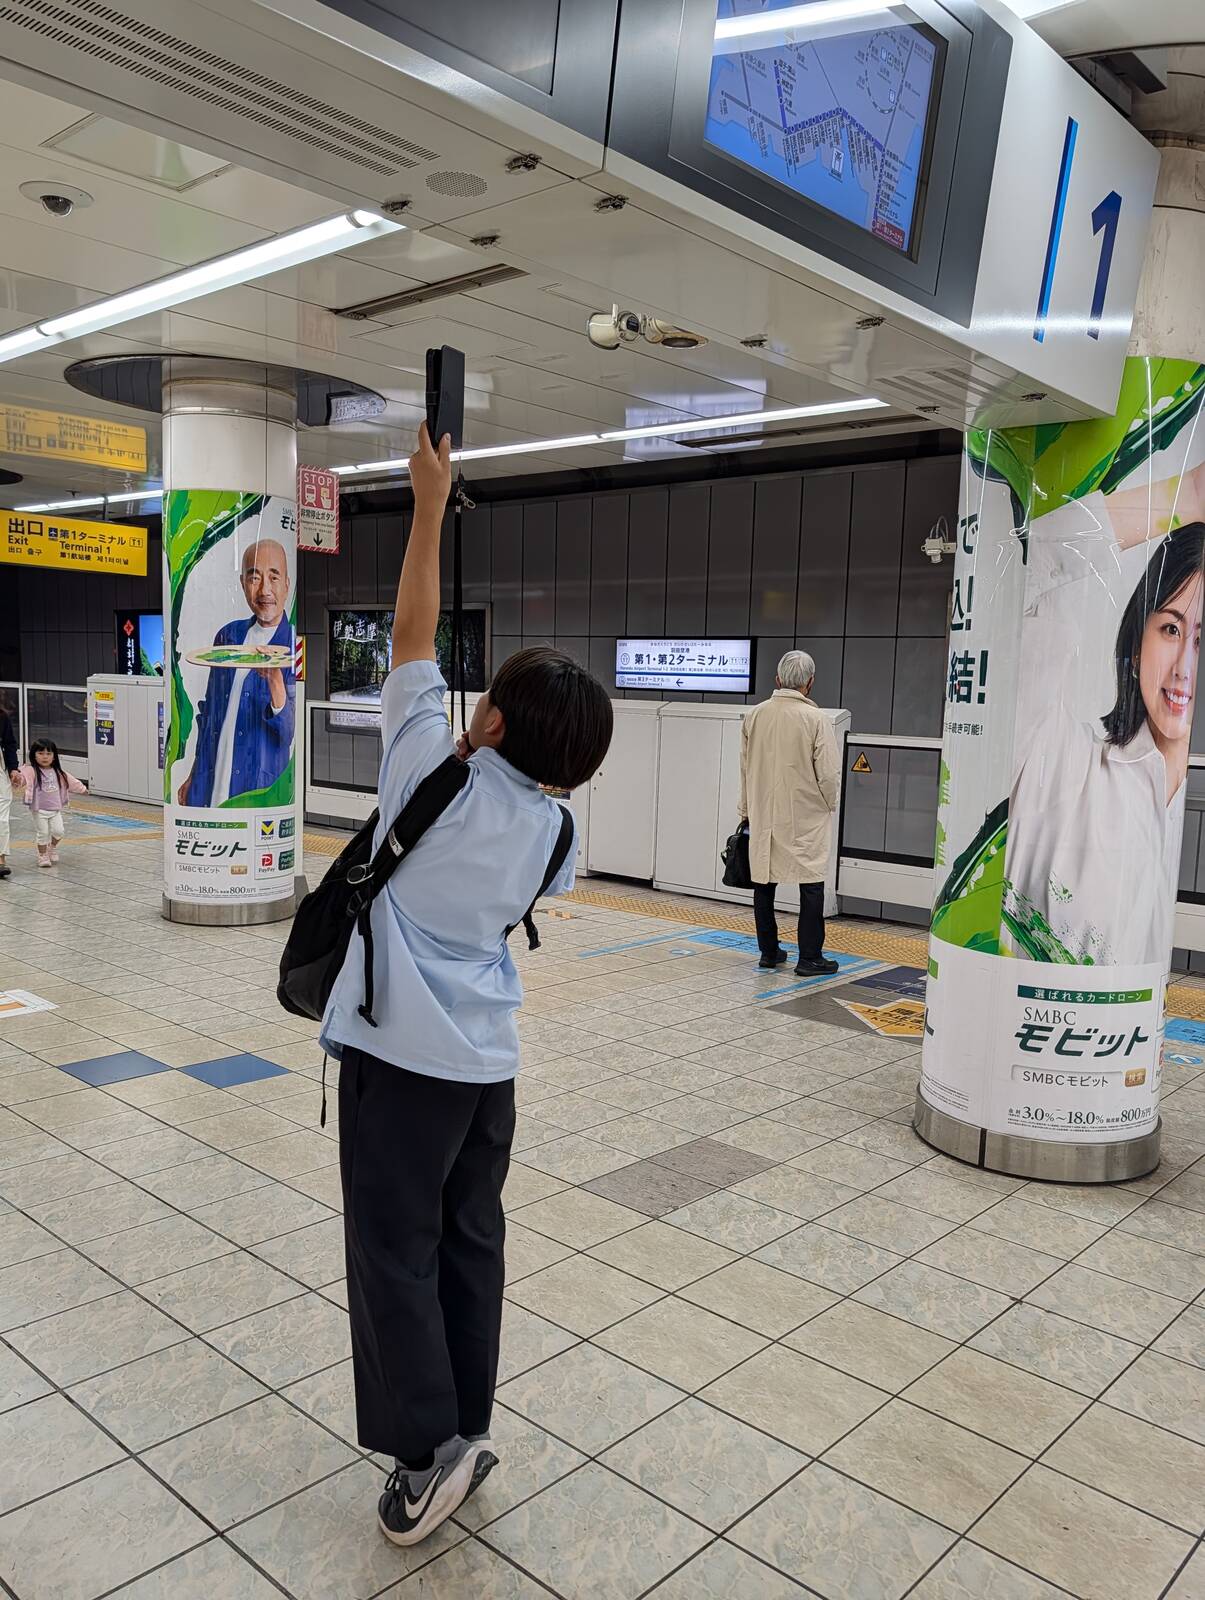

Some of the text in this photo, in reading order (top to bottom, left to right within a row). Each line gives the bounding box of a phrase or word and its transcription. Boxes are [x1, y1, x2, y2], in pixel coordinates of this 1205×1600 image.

[1087, 190, 1123, 341] 1
[304, 473, 333, 487] STOP
[301, 508, 336, 522] 非常停止ボタン
[8, 518, 44, 536] 出口
[8, 534, 29, 546] Exit
[60, 528, 127, 546] 第1ターミナル
[8, 546, 23, 554] 出口
[60, 541, 111, 554] Terminal 1
[333, 620, 378, 640] 伊勢志摩
[634, 653, 729, 666] 第1・第2ターミナル
[181, 821, 240, 829] 選ばれるカードローン
[177, 831, 200, 840] SMBC
[175, 840, 248, 857] モビット
[179, 865, 220, 874] SMBCモビット
[1034, 988, 1143, 1002] 選ばれるカードローン
[1023, 1006, 1077, 1026] SMBC
[1014, 1023, 1149, 1058] モビット
[1023, 1070, 1109, 1088] SMBCモビット
